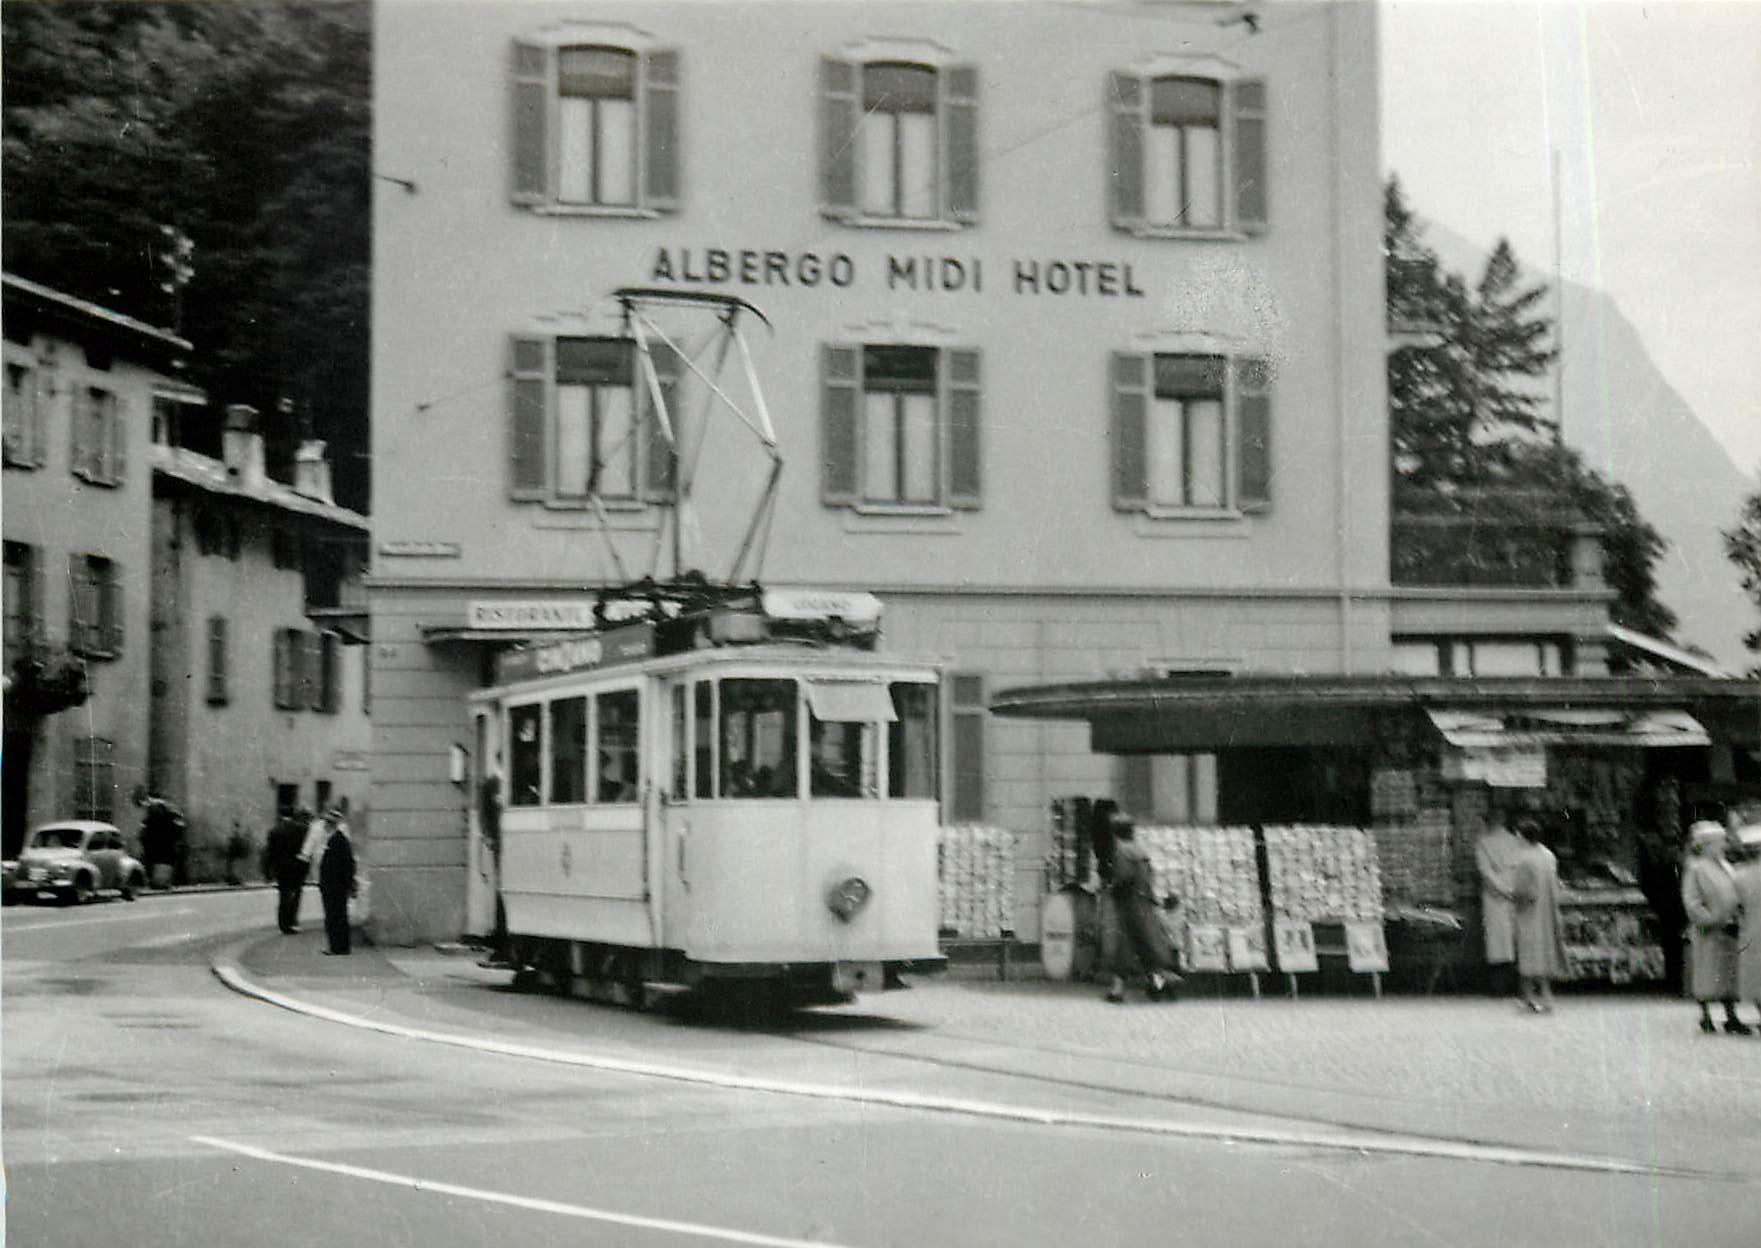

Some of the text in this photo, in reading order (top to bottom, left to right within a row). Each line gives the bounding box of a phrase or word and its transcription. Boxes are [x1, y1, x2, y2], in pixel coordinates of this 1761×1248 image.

[654, 247, 1147, 298] ALBERGO MIDI HOTEL
[475, 606, 584, 624] RISTORANTE
